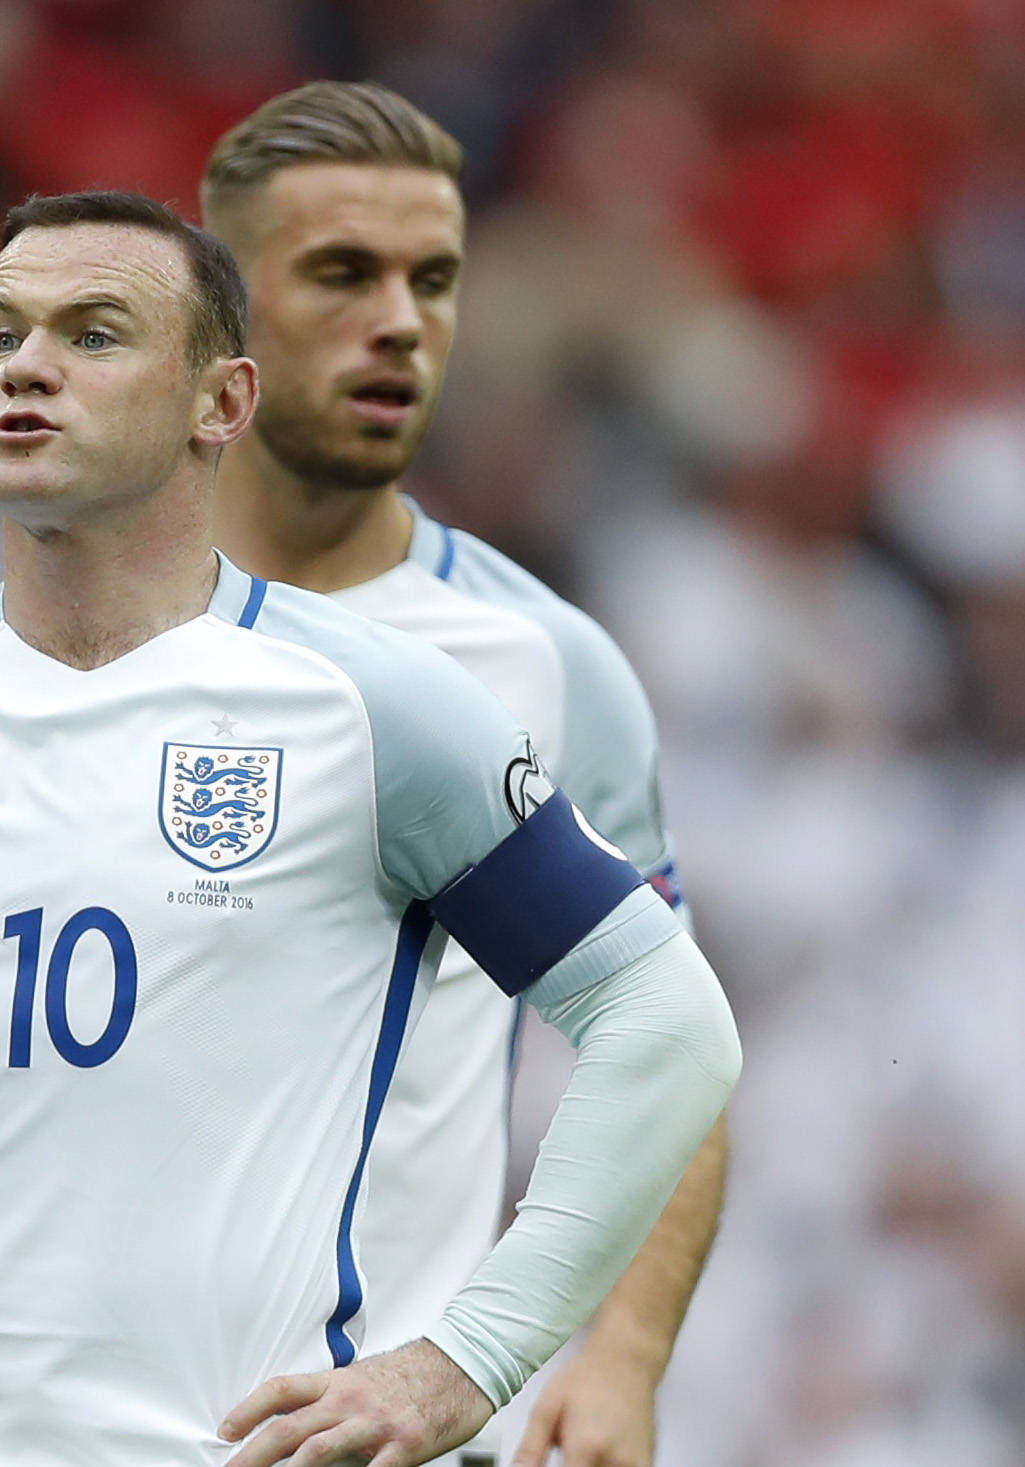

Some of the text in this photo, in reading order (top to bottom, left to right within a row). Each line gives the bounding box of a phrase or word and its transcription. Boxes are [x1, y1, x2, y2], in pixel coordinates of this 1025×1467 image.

[195, 879, 230, 894] MALTA
[167, 891, 254, 910] 8 OCTOBER 2016
[3, 906, 138, 1068] 10
